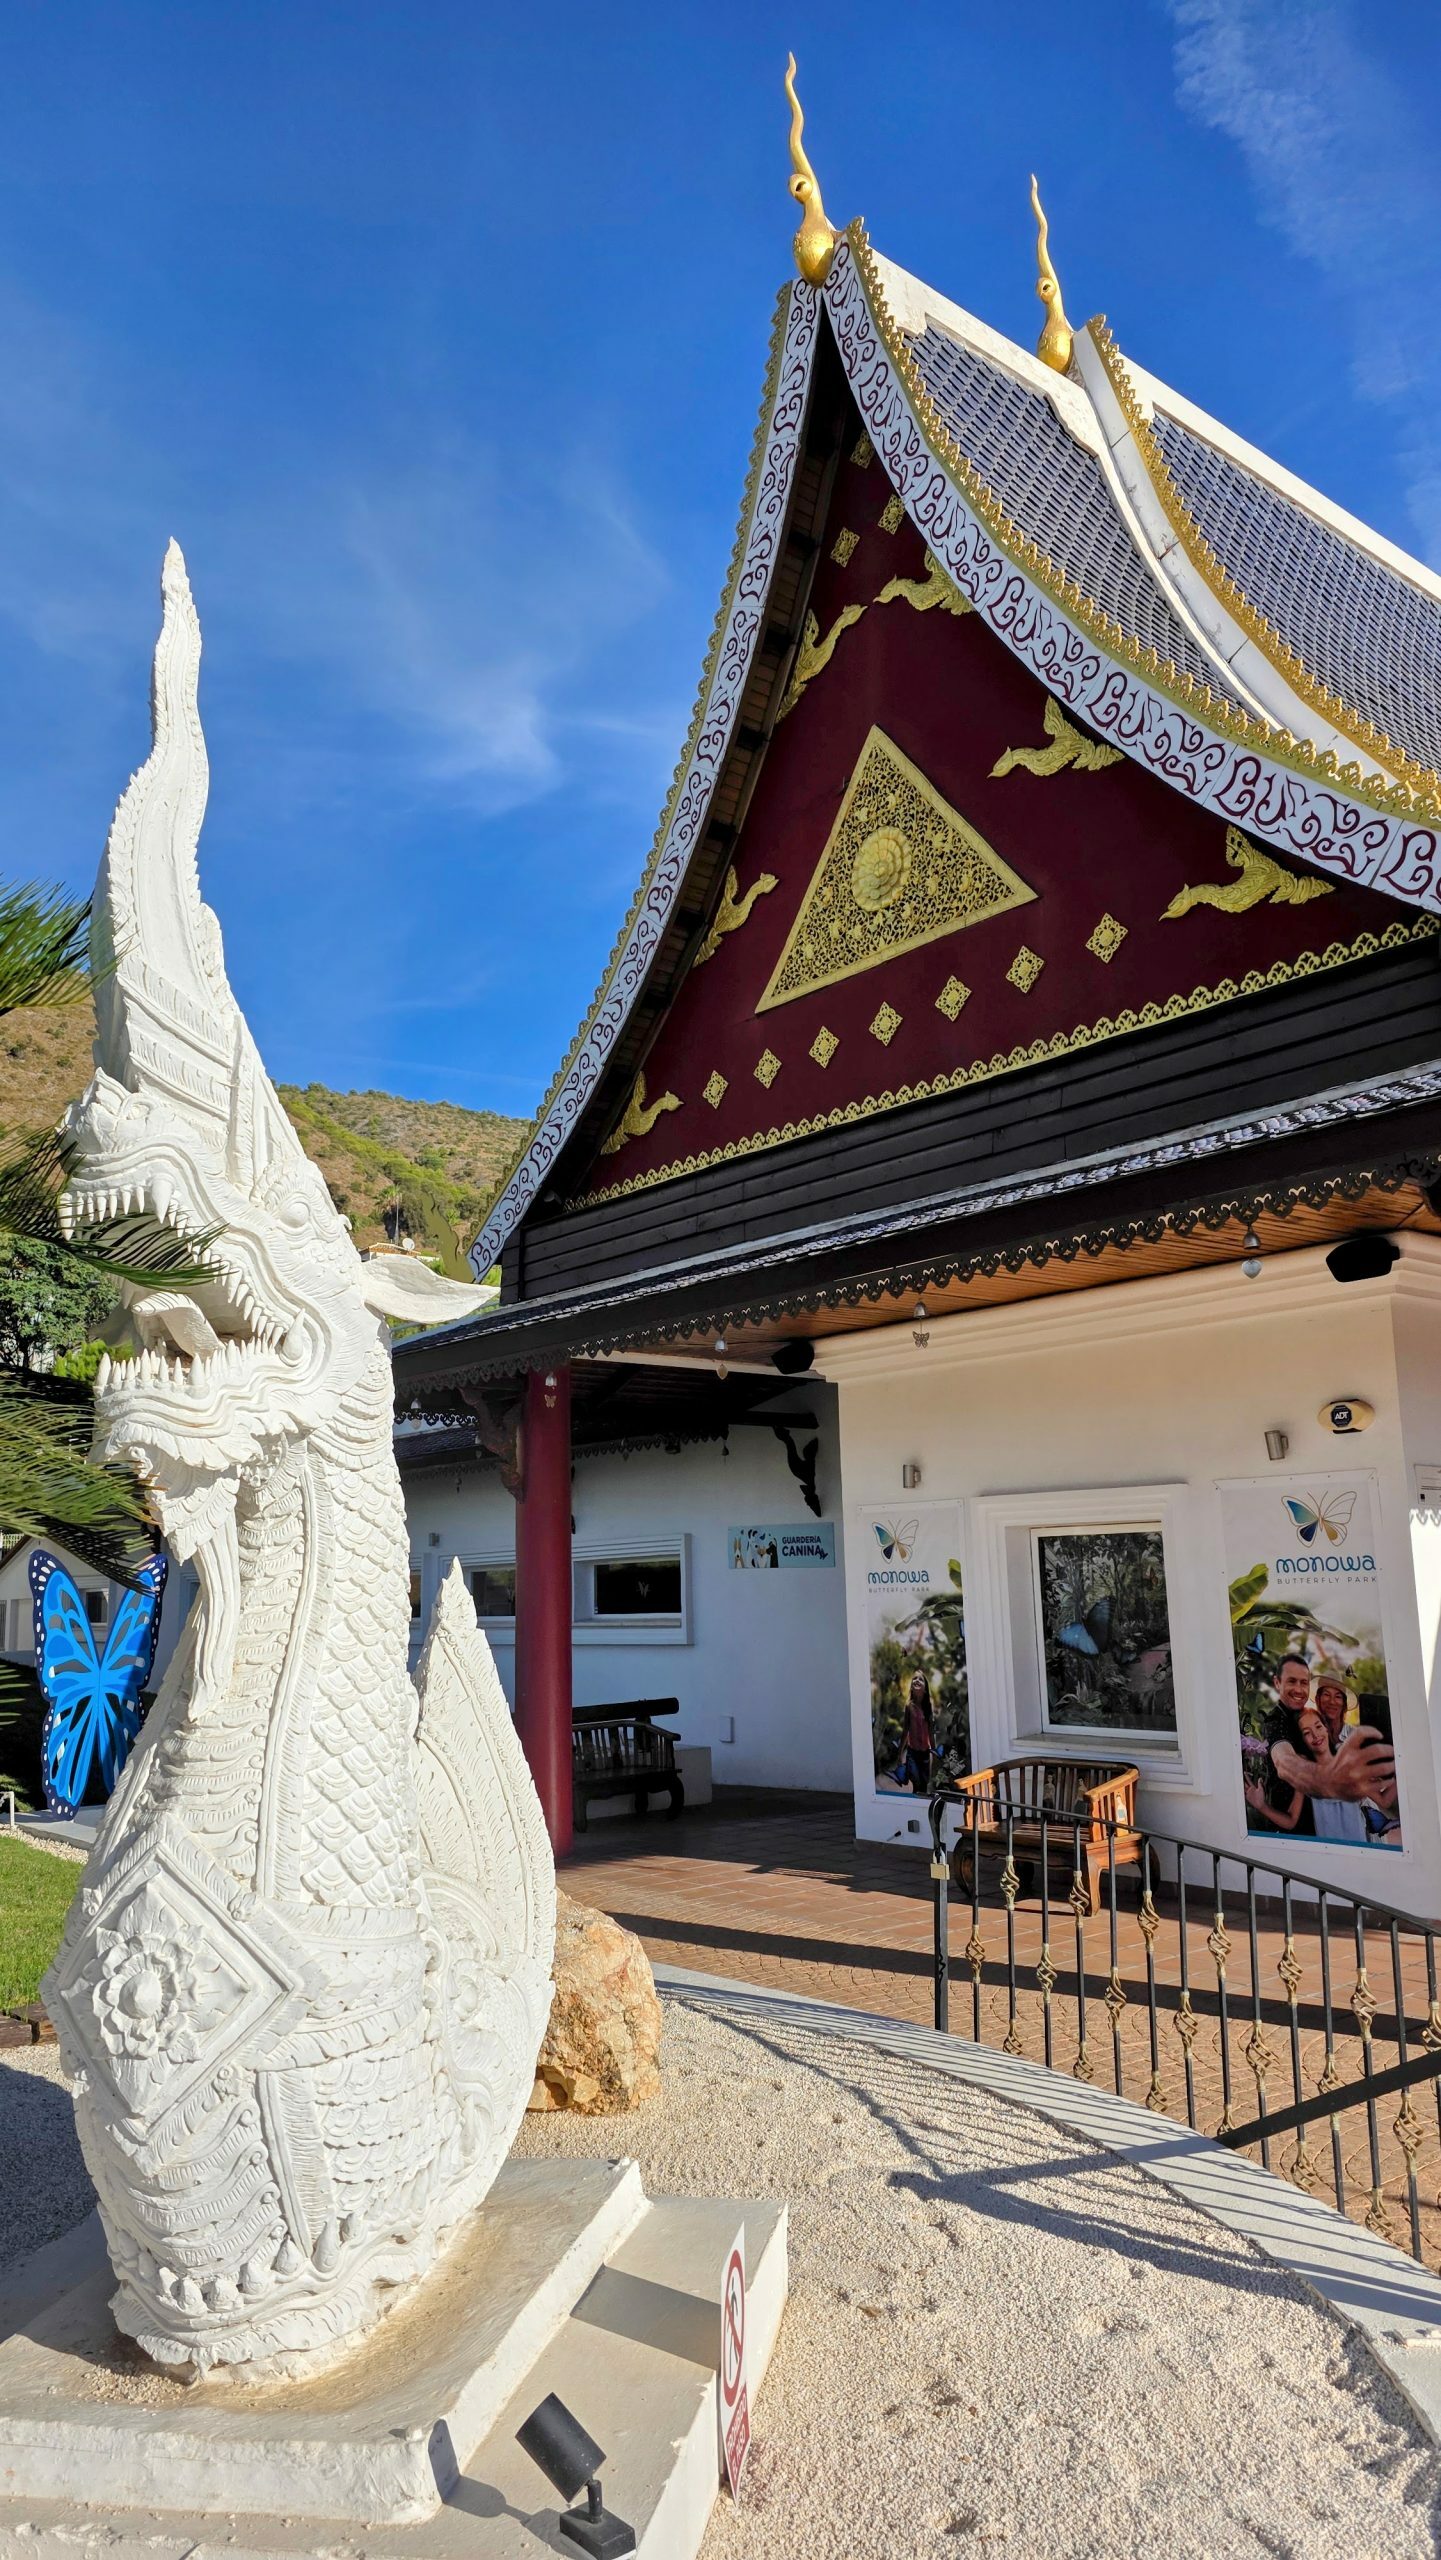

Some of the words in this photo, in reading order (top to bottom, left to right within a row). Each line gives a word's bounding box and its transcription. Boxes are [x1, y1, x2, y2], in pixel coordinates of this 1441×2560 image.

[1334, 1411, 1349, 1420] ADT
[781, 1545, 821, 1557] CANINA
[1276, 1555, 1377, 1573] monowa
[868, 1570, 929, 1584] monowa
